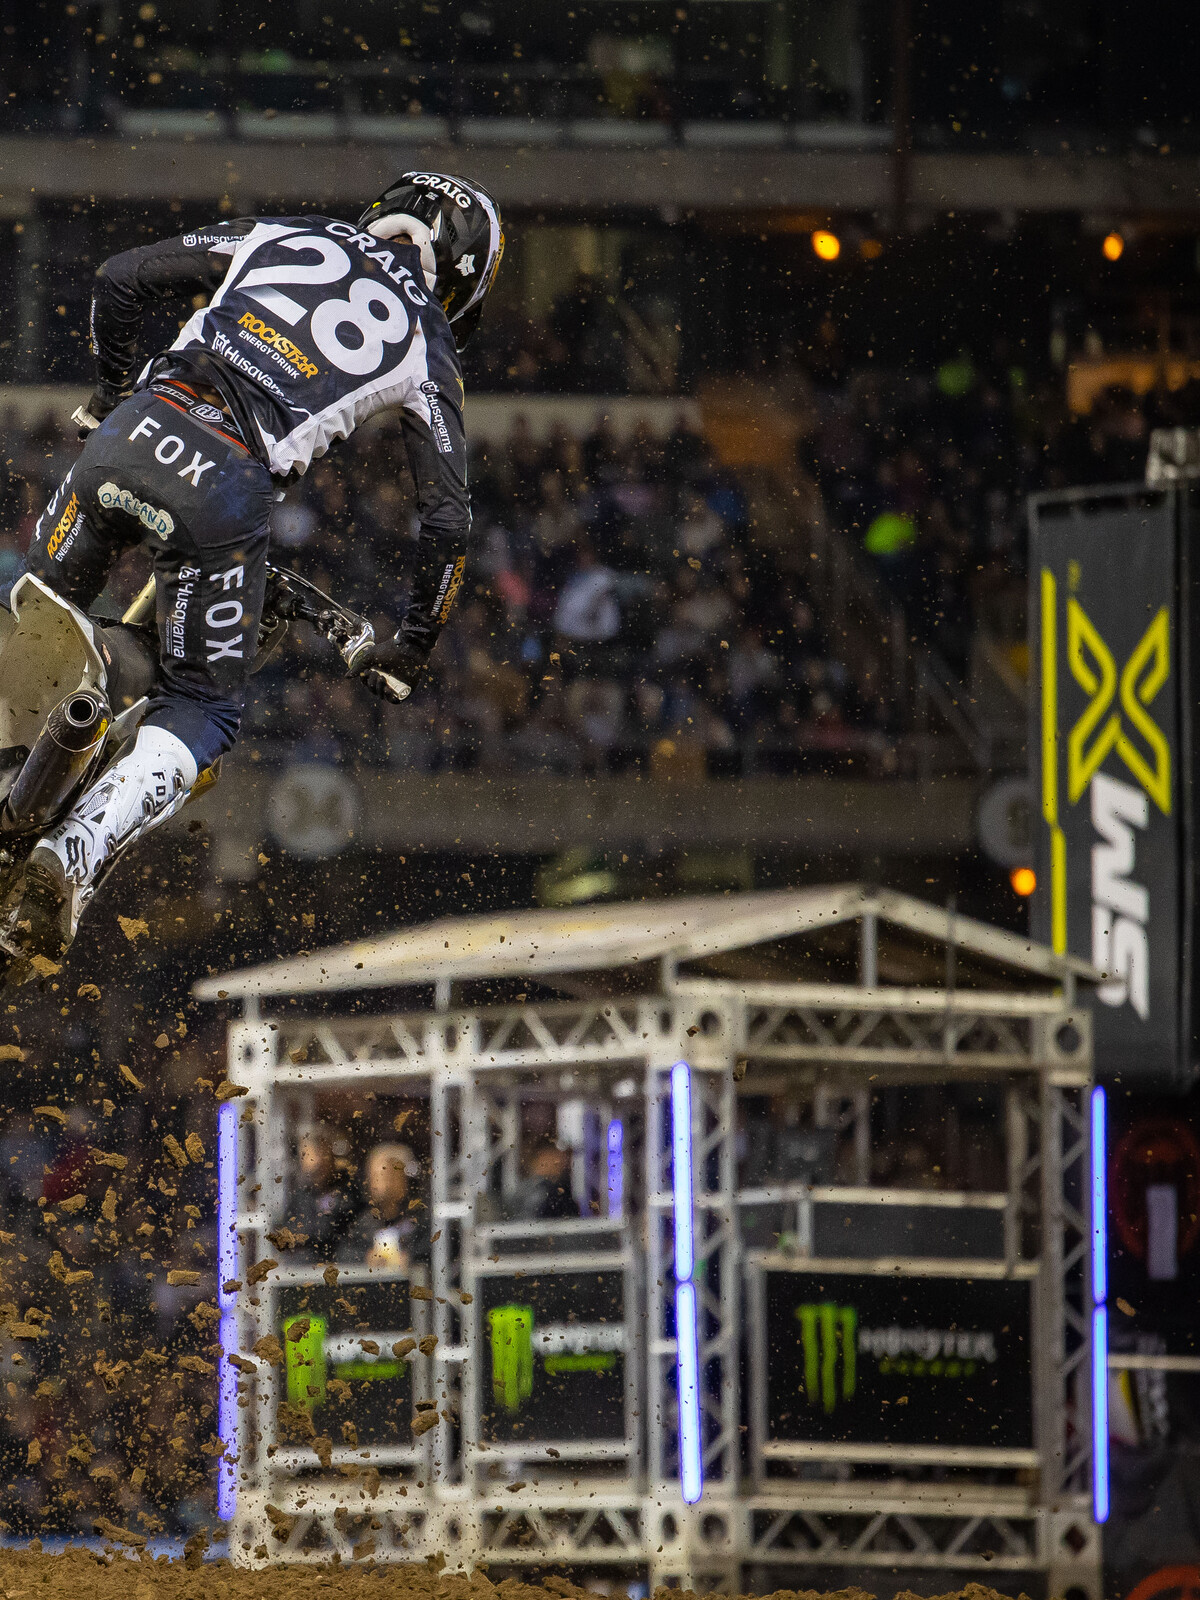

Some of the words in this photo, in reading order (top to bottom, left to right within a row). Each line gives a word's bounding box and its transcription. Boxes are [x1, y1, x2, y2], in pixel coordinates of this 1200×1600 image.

[412, 175, 471, 208] CRAIG
[325, 223, 429, 305] CRAIG
[234, 236, 409, 376] 28
[237, 312, 319, 379] ROCKSTAR
[238, 330, 274, 356] ENERGY
[271, 352, 300, 380] DRINK
[128, 416, 217, 488] FOX
[426, 393, 453, 453] Husqvarna
[101, 493, 167, 533] OAKLAND
[439, 564, 454, 594] ENERGY
[172, 582, 194, 658] Husqvarna
[206, 565, 243, 663] FOX
[53, 826, 68, 841] FOX
